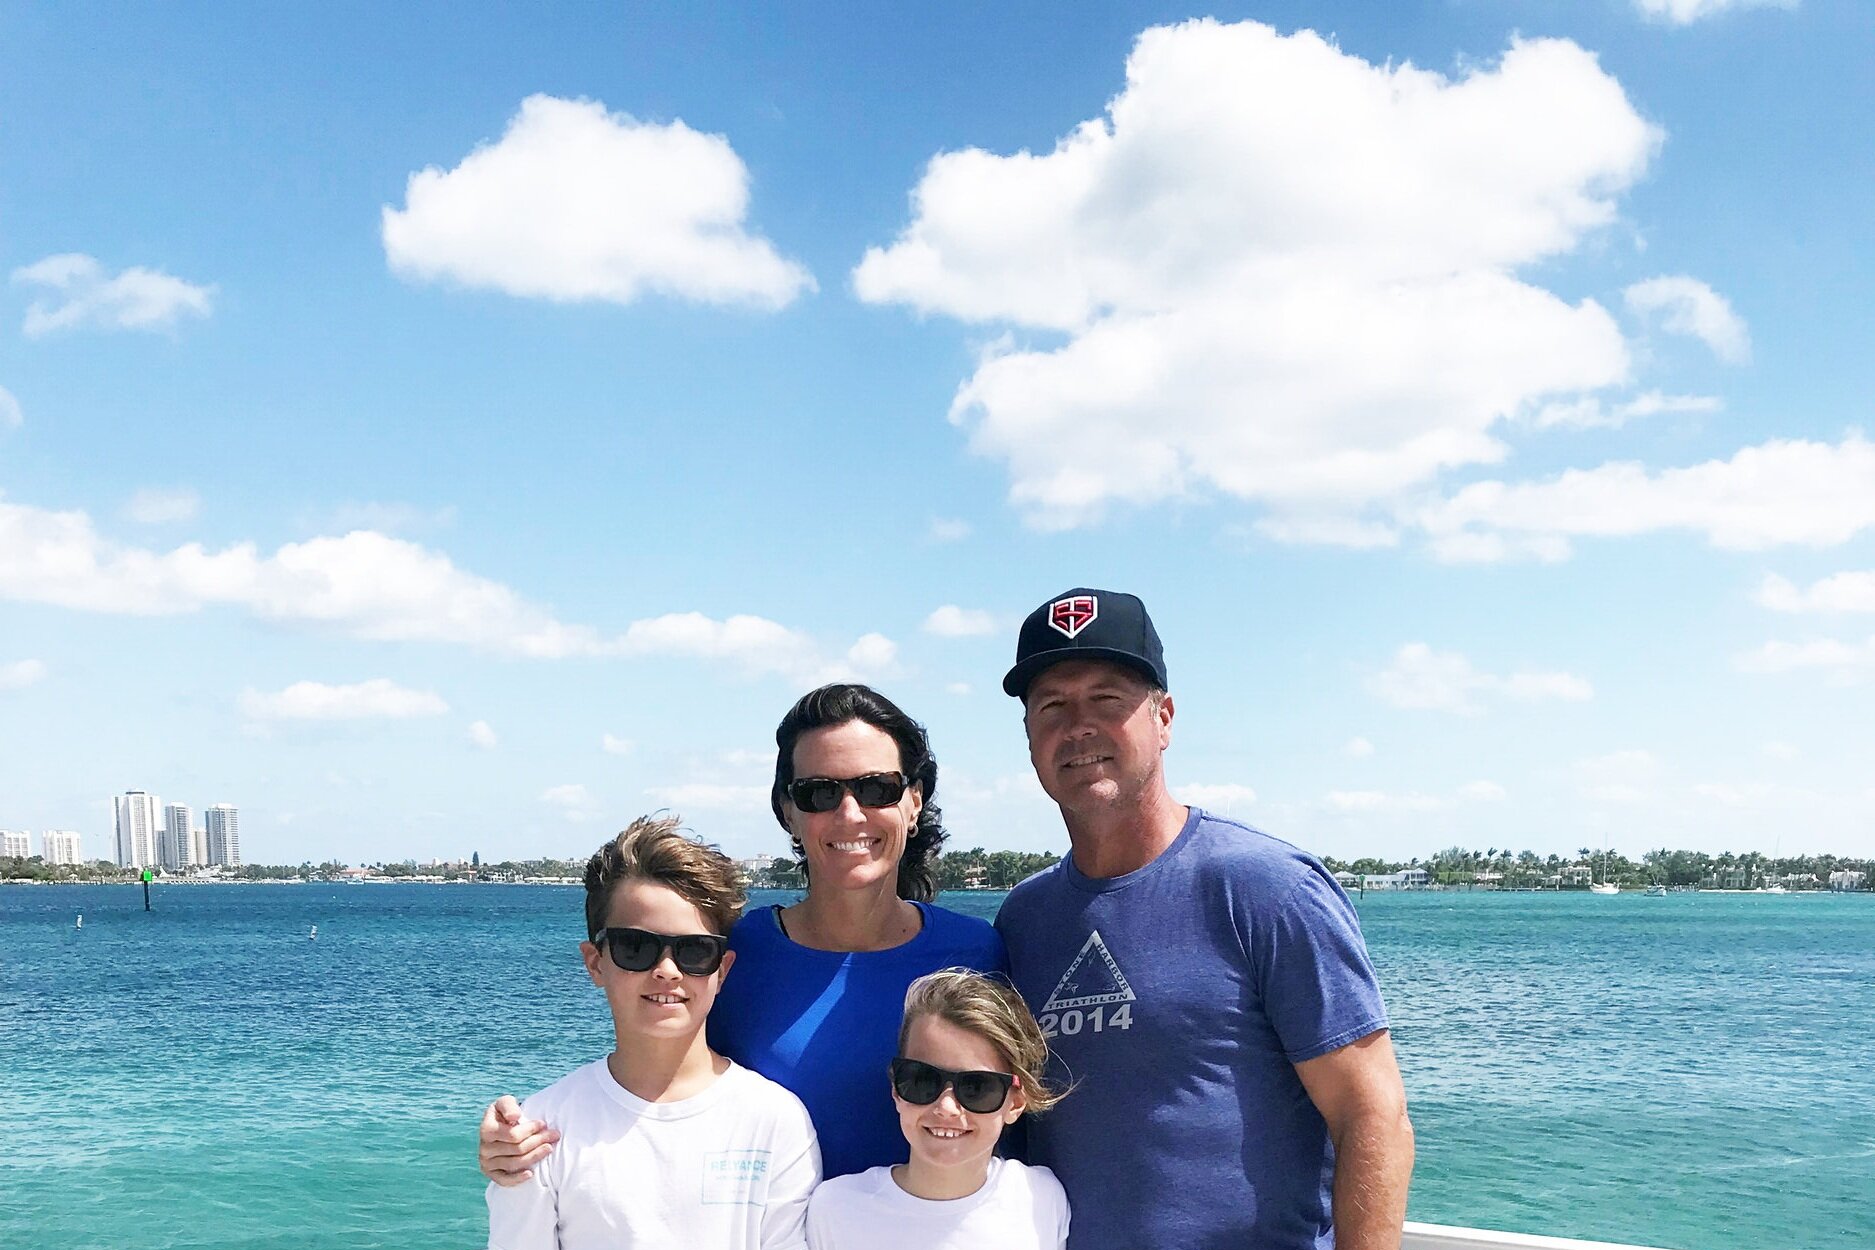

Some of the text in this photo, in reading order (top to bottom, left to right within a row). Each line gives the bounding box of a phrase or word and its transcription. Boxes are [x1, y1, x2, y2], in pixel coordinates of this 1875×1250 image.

[1096, 943, 1129, 991] HARBOR
[1047, 993, 1128, 1009] TRIATHLON
[1038, 1003, 1134, 1039] 2014
